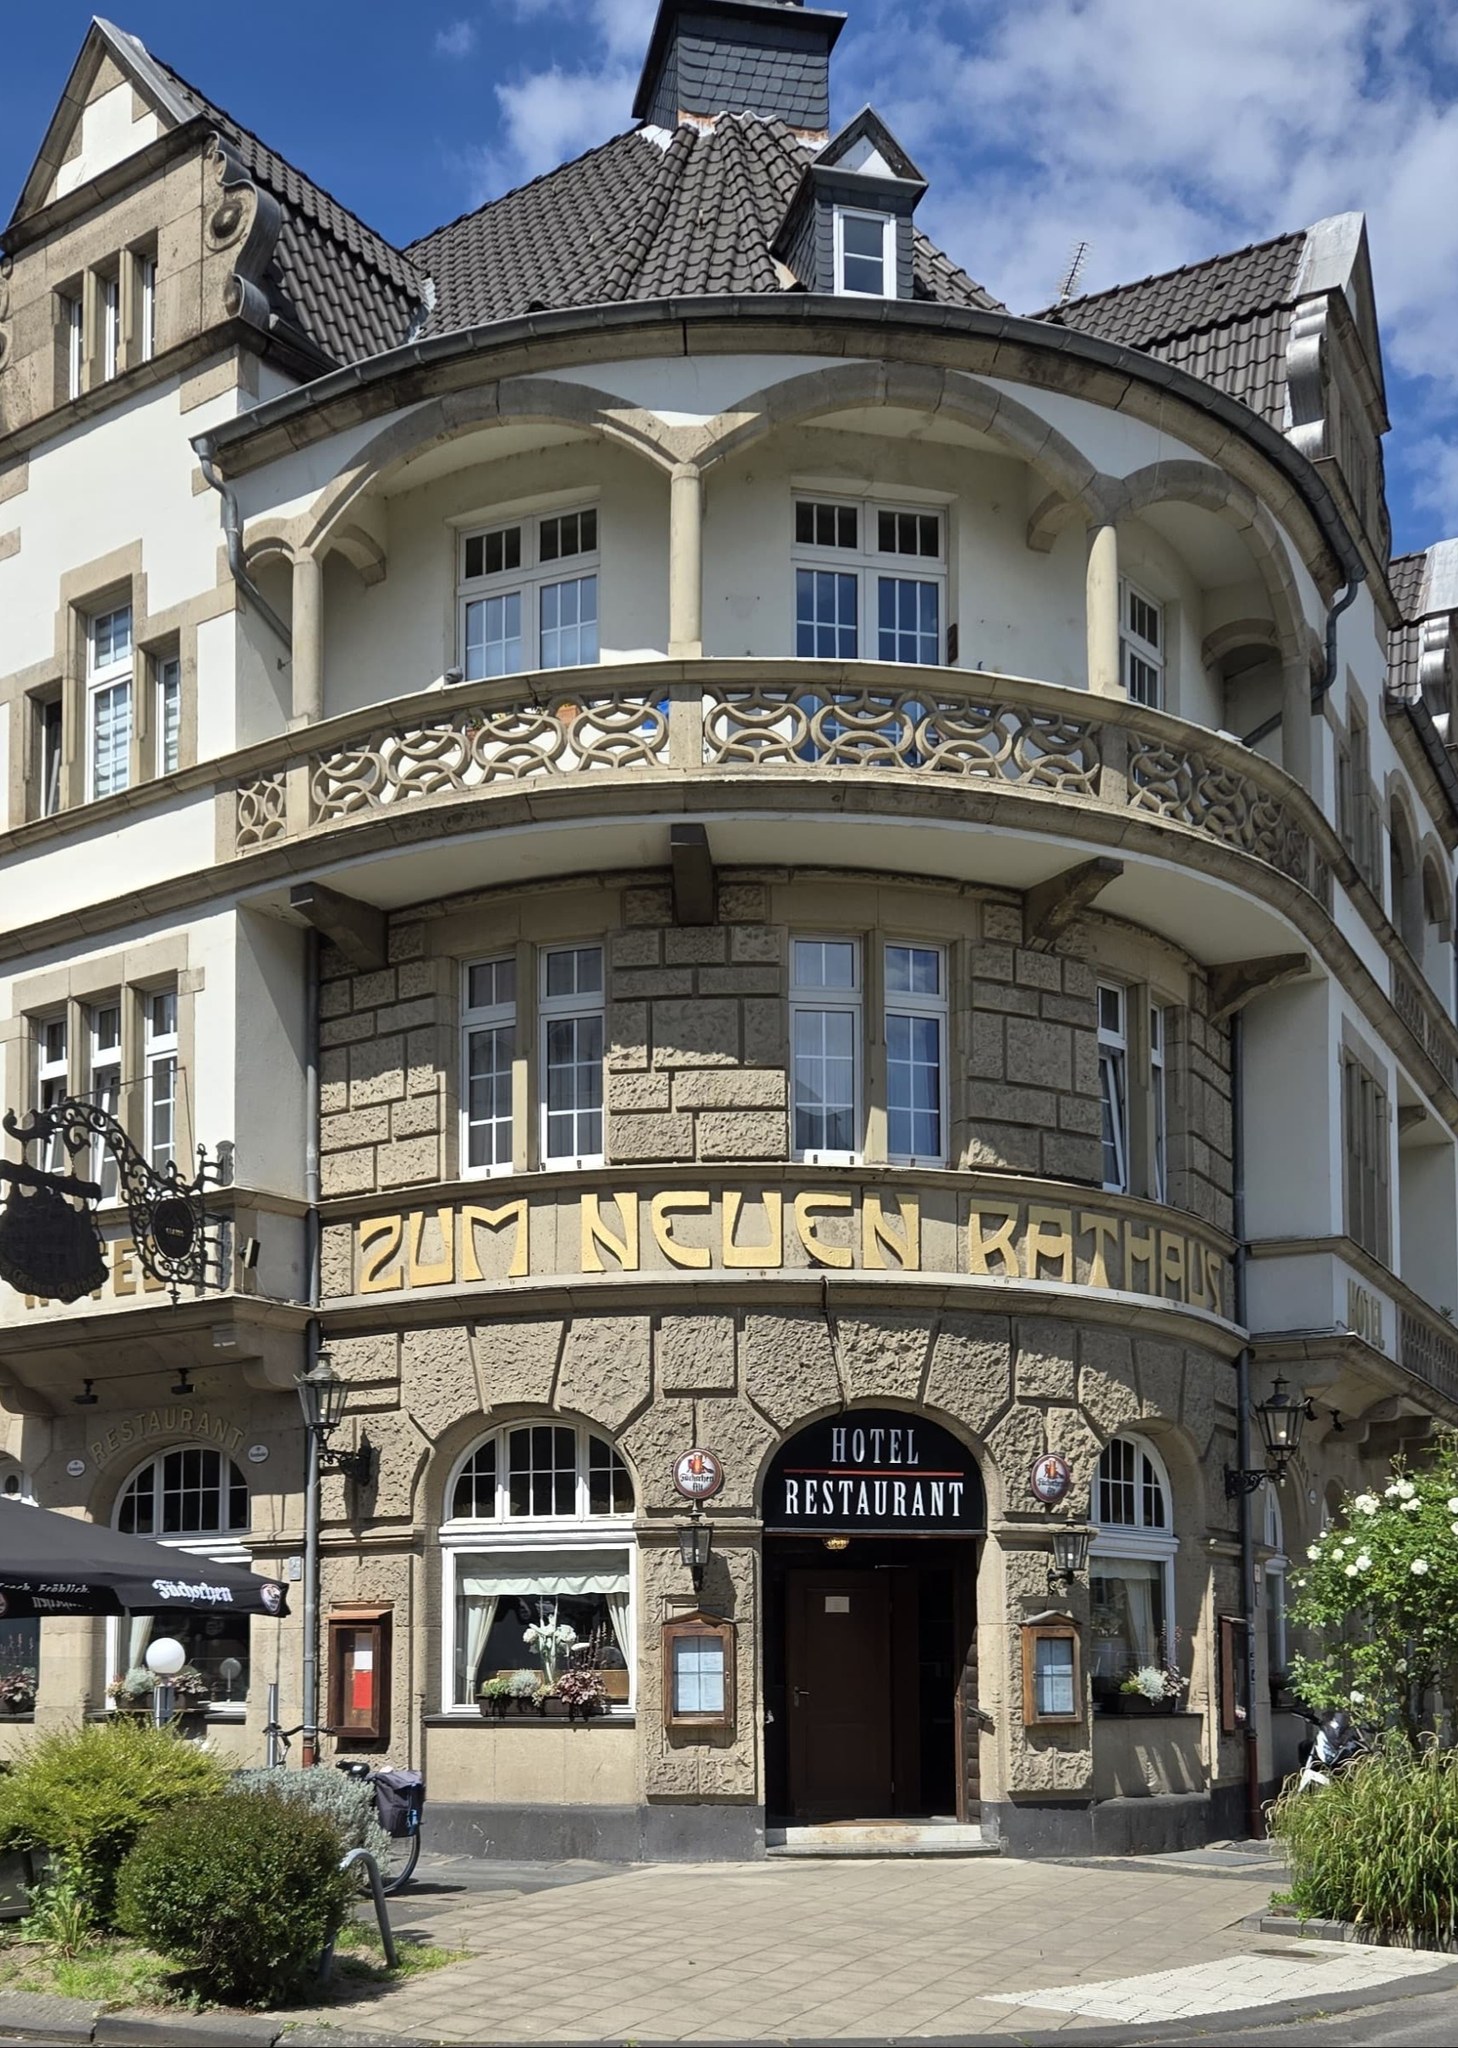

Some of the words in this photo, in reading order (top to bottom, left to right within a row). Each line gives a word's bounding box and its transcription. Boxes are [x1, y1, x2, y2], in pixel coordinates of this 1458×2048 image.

[360, 1199, 529, 1293] ZUM
[581, 1190, 920, 1273] NEUEN
[969, 1199, 1222, 1317] RATHAUS
[90, 1408, 245, 1464] RESTAURANT
[832, 1428, 919, 1464] HOTEL
[785, 1479, 964, 1517] RESTAURANT
[152, 1579, 234, 1605] Füchschen
